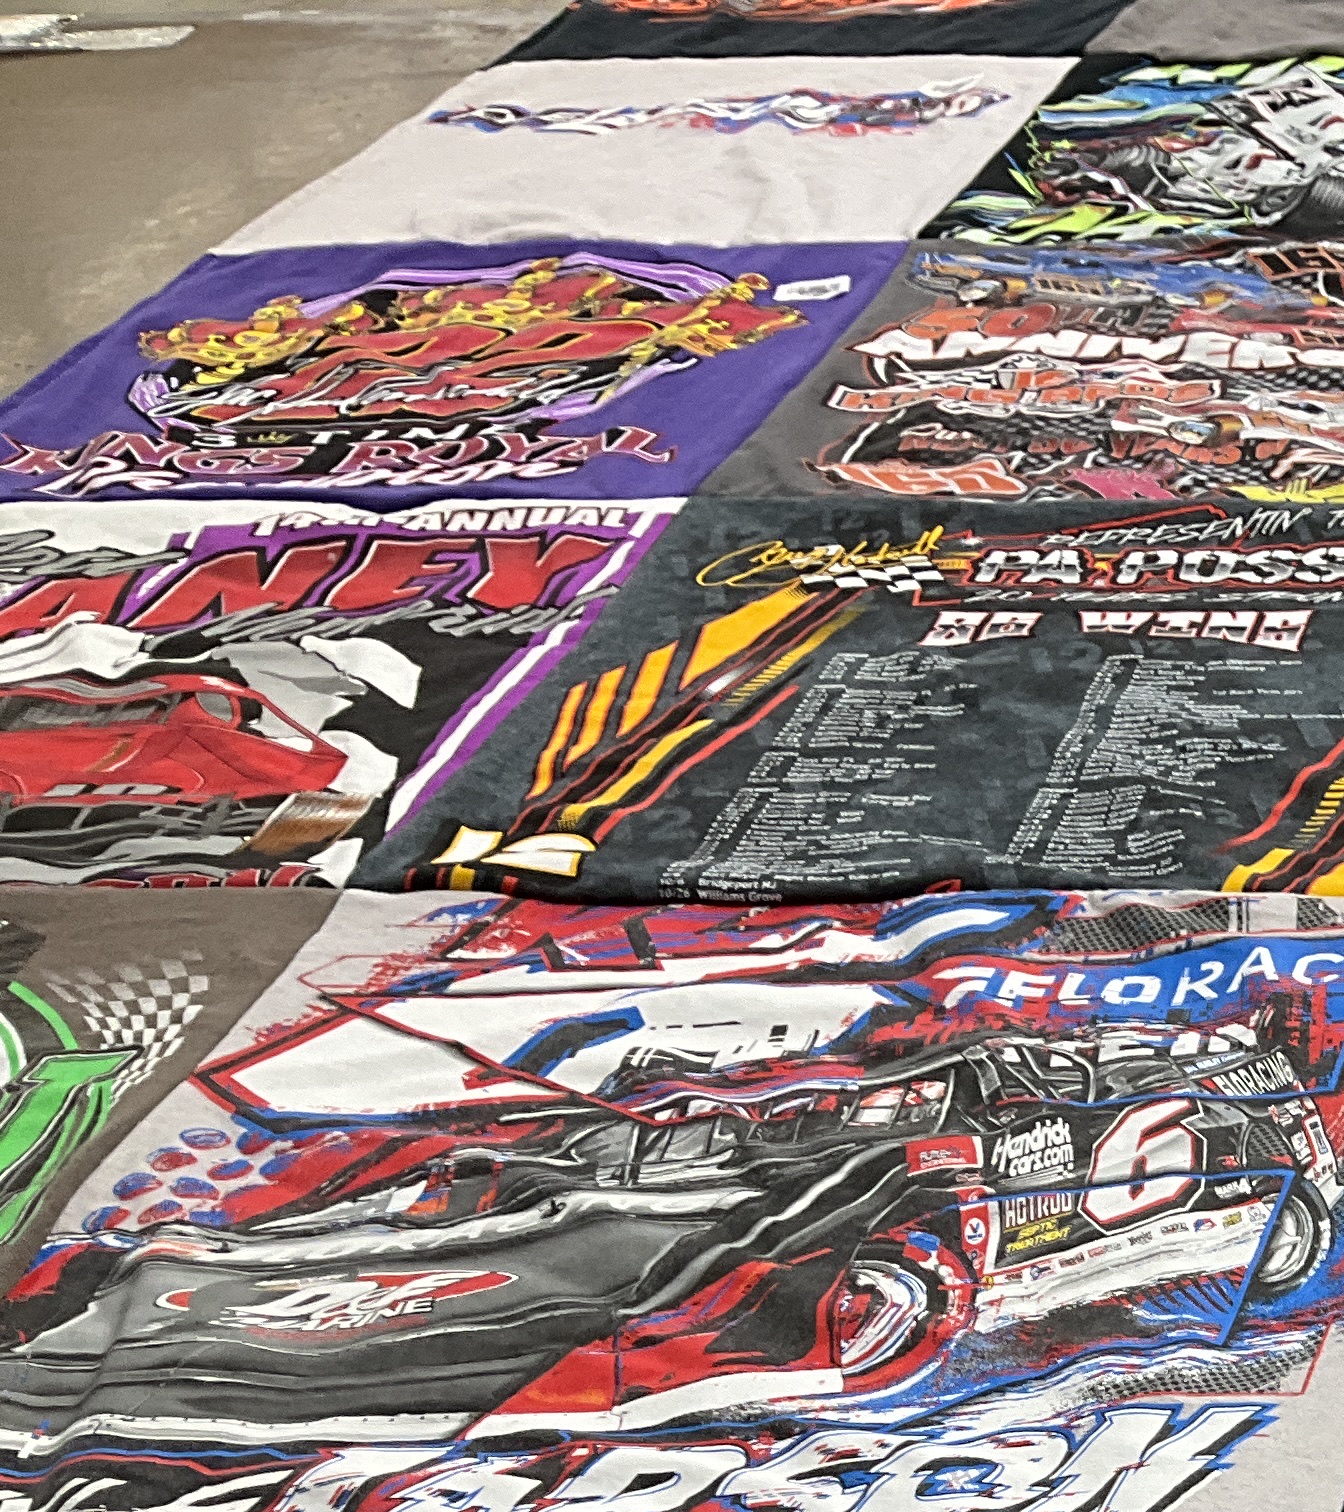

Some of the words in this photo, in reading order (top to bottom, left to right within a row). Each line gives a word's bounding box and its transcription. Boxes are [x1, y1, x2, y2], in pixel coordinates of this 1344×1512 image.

[191, 432, 237, 447] 3
[331, 426, 678, 473] ROYAL
[401, 506, 627, 531] ANNUAL
[973, 548, 1090, 584] PA
[1078, 610, 1314, 653] WINS
[1079, 1098, 1197, 1225] 6
